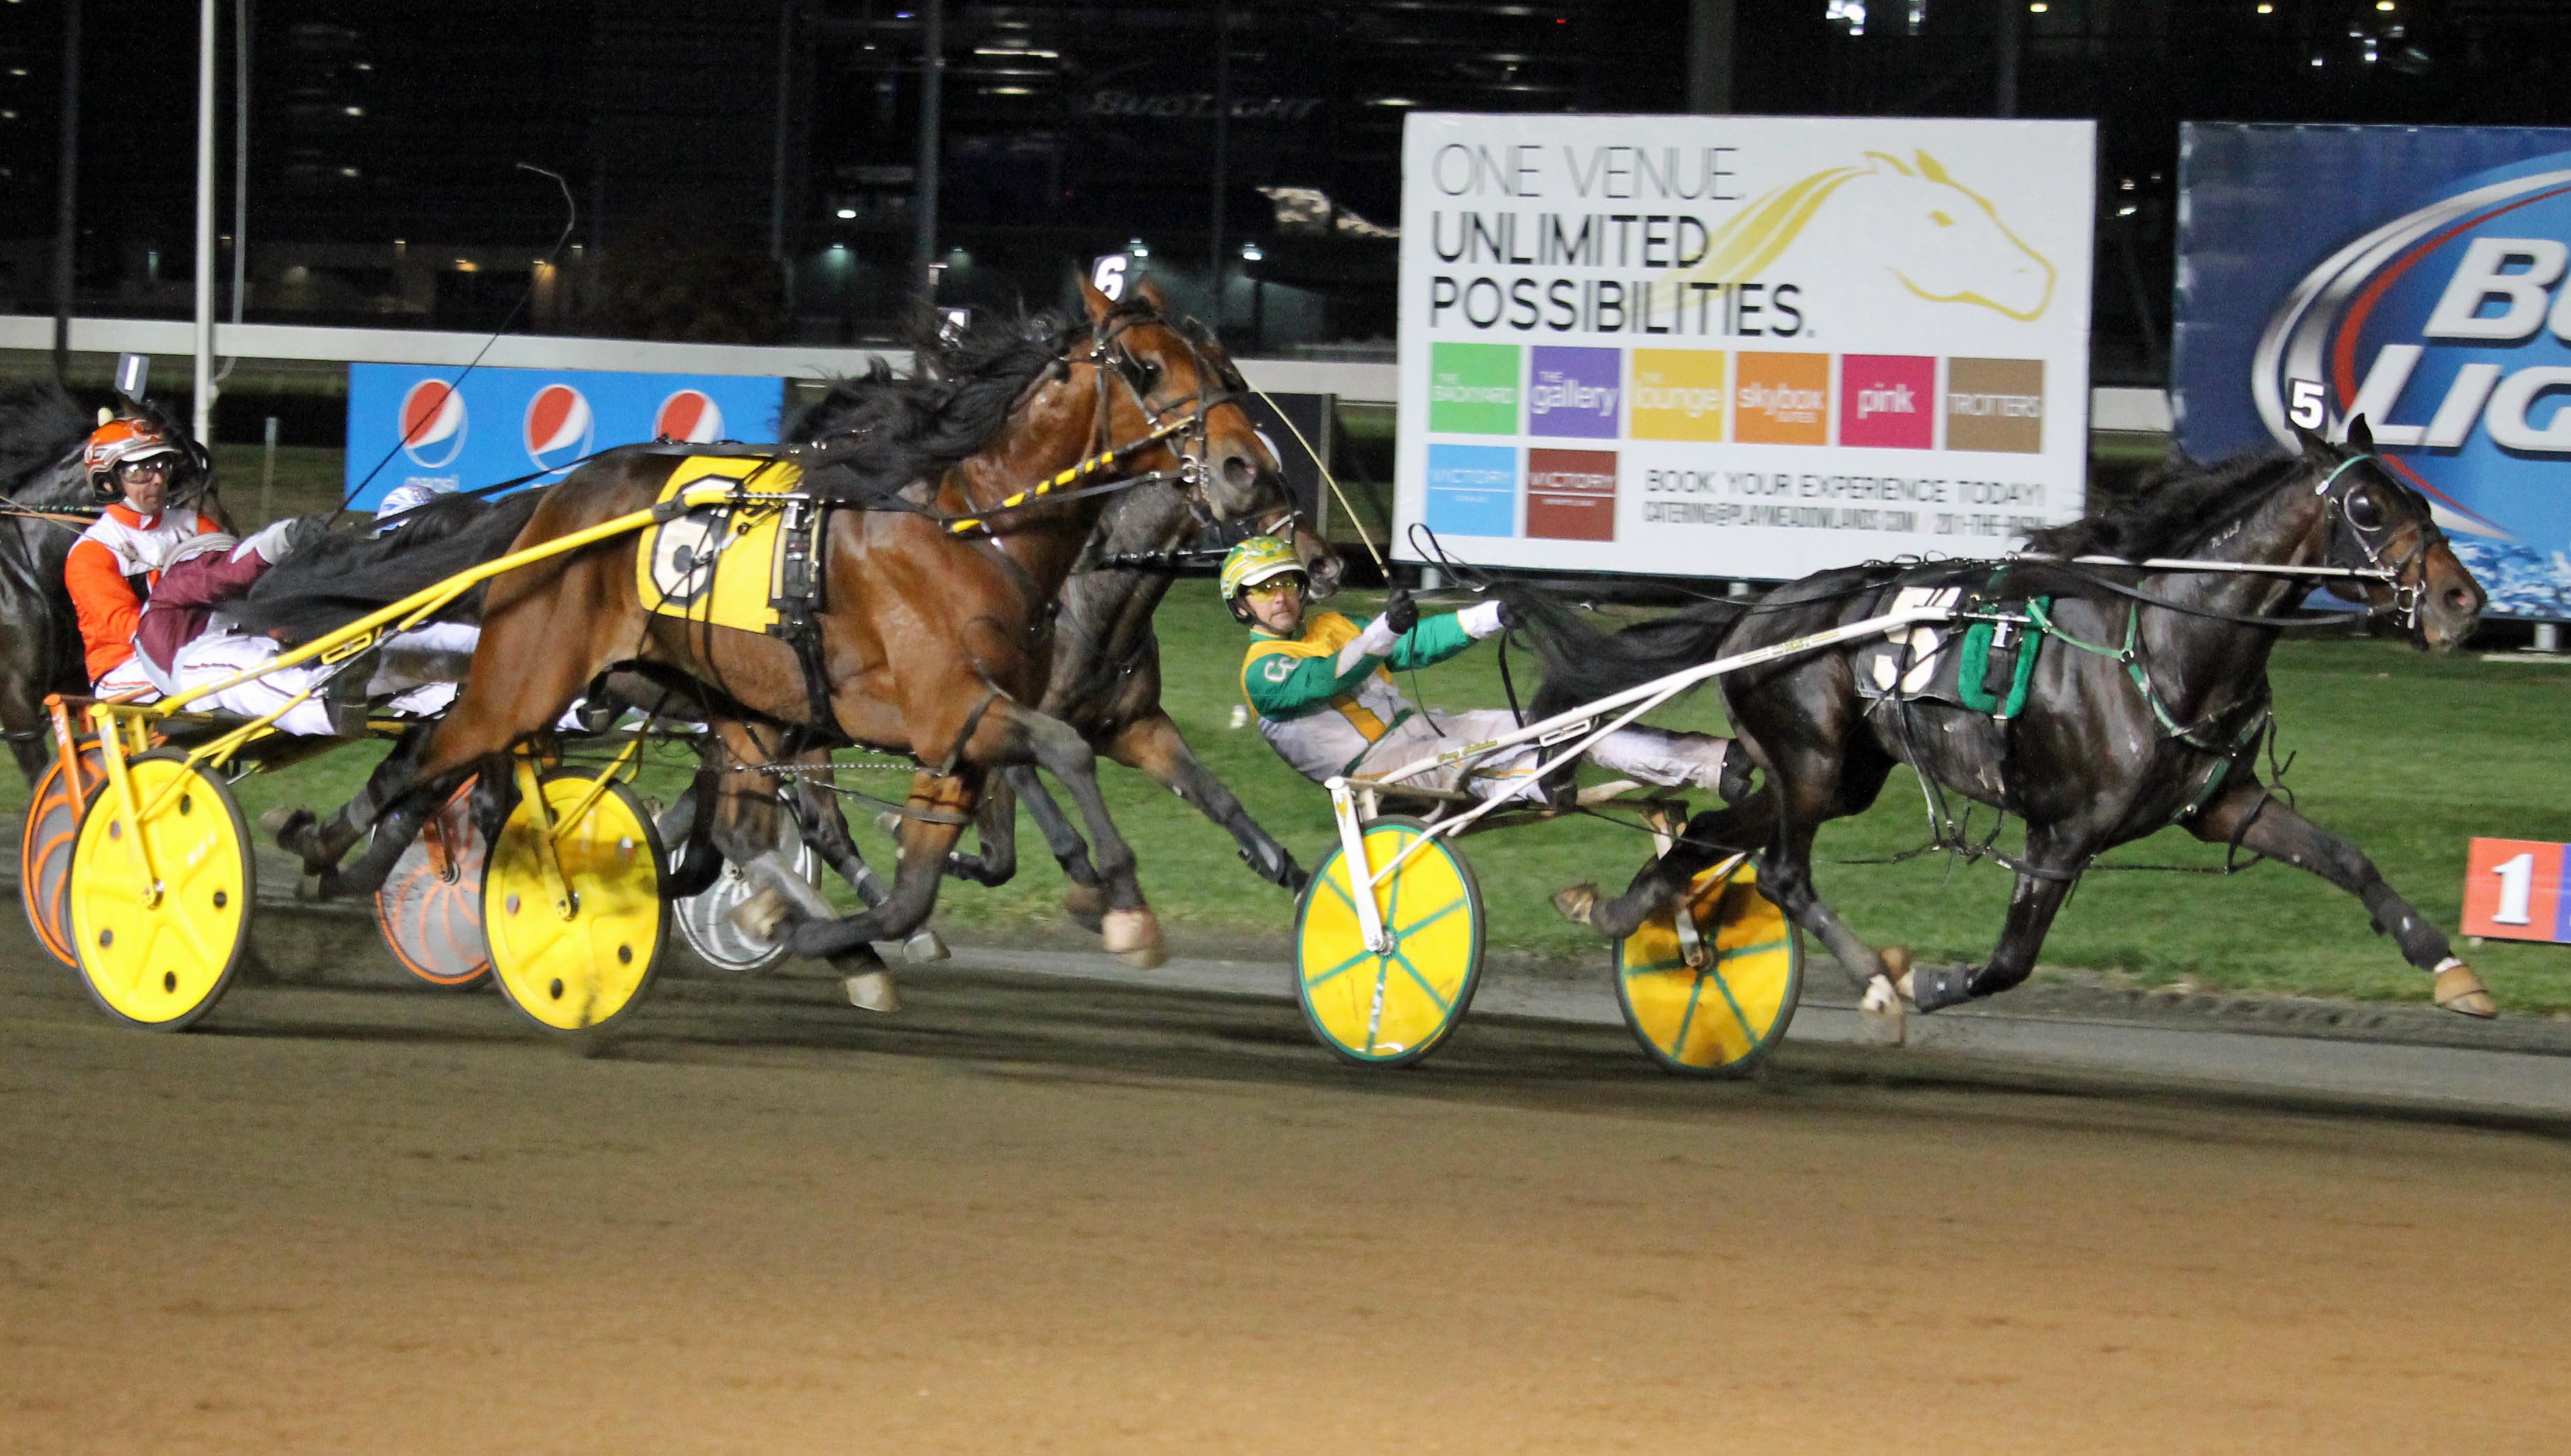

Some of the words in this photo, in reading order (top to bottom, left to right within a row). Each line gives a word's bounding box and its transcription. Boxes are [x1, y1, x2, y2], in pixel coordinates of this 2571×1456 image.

[1432, 144, 1541, 198] ONE
[1432, 211, 1710, 269] UNLIMITED
[1093, 255, 1127, 301] 6
[2421, 237, 2571, 343] B
[1429, 276, 1816, 339] POSSIBILITIES.
[1538, 370, 1564, 383] THE
[1531, 380, 1619, 417] gallery
[1630, 380, 1723, 418] lounge
[1737, 382, 1826, 416] skybox
[1857, 383, 1916, 420] pink
[1948, 393, 2042, 419] TROTTERS
[2288, 381, 2325, 429] 5
[1430, 469, 1515, 484] VICTORY
[1529, 472, 1616, 488] VICTORY
[1647, 469, 1716, 493] BOOK
[1724, 472, 1792, 497] YOUR
[1799, 474, 1947, 502] EXPERIENCE
[1956, 480, 2046, 506] TODAY!
[2491, 853, 2535, 924] 1
